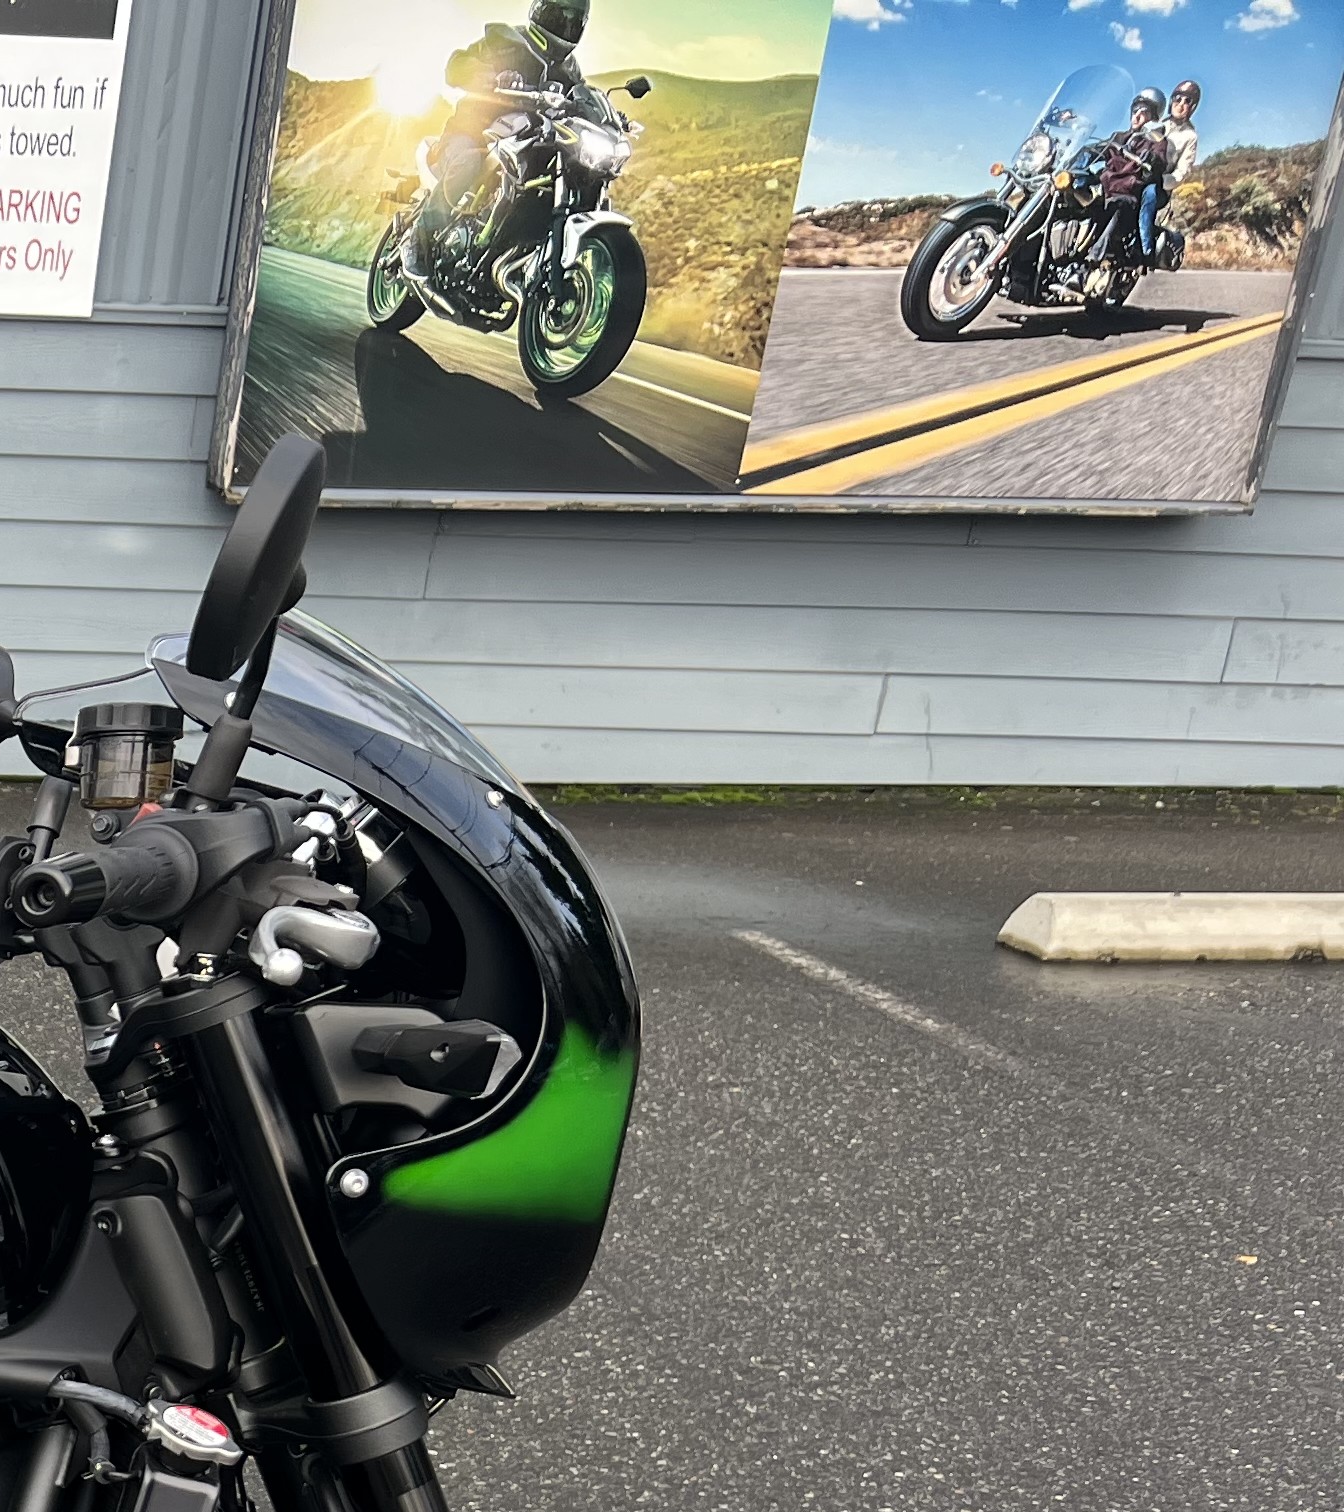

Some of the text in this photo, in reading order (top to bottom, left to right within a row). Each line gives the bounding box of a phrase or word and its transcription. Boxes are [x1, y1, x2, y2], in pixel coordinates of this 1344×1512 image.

[53, 77, 85, 109] fun
[93, 77, 109, 111] if
[9, 125, 77, 157] towed.
[24, 239, 74, 281] Only
